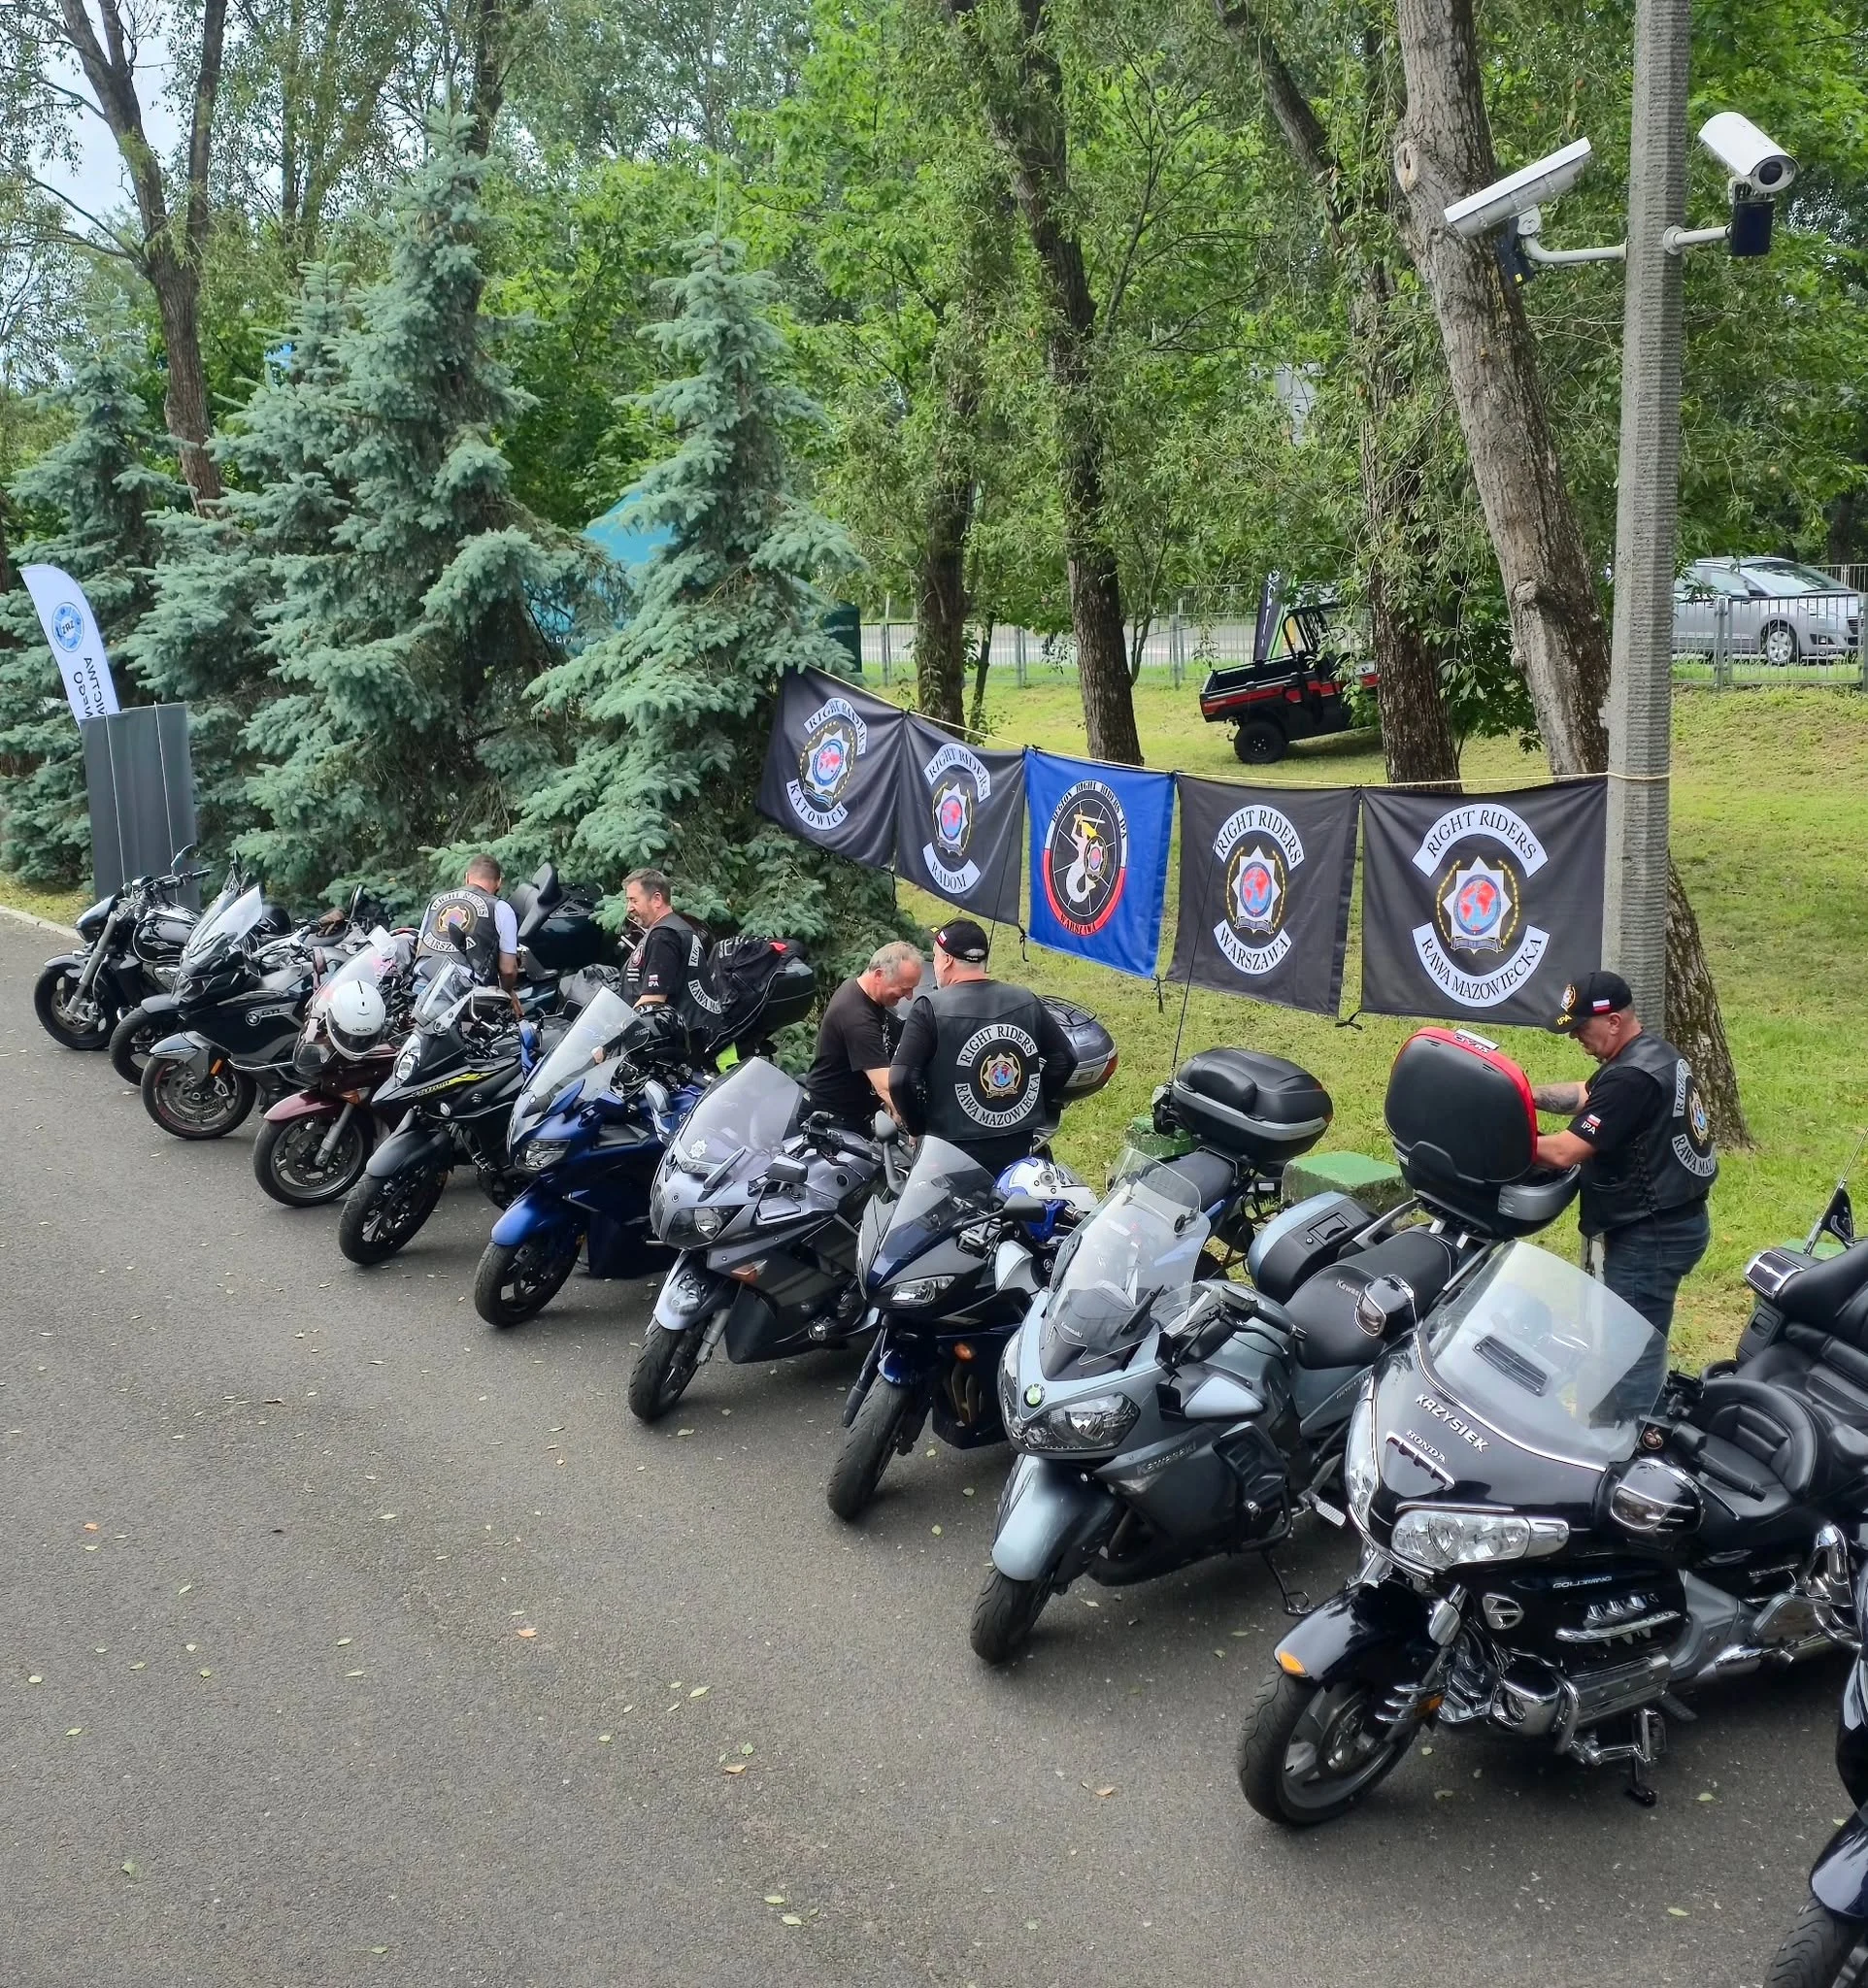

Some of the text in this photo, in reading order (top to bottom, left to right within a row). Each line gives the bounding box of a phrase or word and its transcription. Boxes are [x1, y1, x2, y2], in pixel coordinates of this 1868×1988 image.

[809, 700, 866, 753] RIGHT RIDERS
[928, 747, 987, 798] RIGHT RIDERS
[790, 783, 846, 826] KATOWICE
[1218, 810, 1302, 863] RIGHT RIDERS
[1427, 810, 1537, 860] RIGHT RIDERS
[931, 861, 967, 890] RADOM
[424, 936, 475, 951] WARSZA
[1220, 926, 1288, 971] WARSZAWA
[1421, 938, 1542, 1000] RAWA MAZOWIECKA
[689, 980, 709, 1009] RAWA
[1556, 1014, 1573, 1026] IPA
[959, 1025, 1036, 1065] RIGHT RIDERS
[957, 1076, 1040, 1126] RAWA MAZOWIECKA
[1581, 1120, 1596, 1135] IPA
[1674, 1136, 1697, 1172] RAWA
[1416, 1393, 1489, 1453] KRZYSIEK
[1406, 1429, 1447, 1465] HONDA
